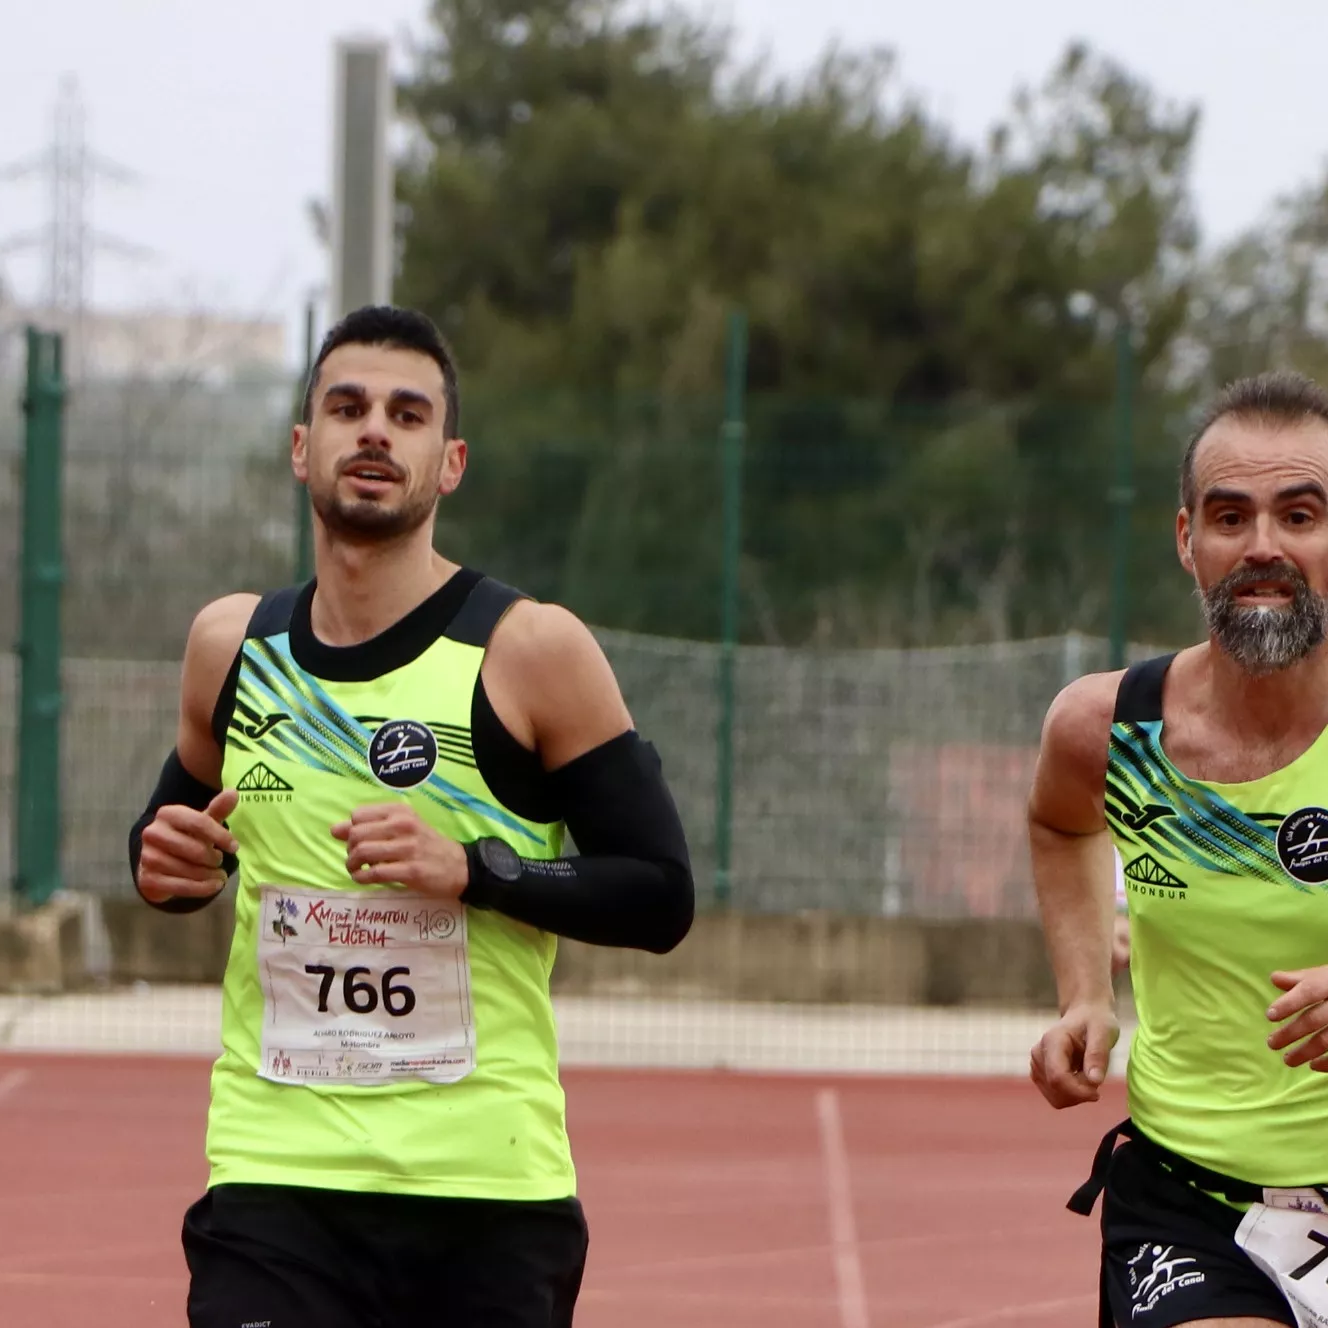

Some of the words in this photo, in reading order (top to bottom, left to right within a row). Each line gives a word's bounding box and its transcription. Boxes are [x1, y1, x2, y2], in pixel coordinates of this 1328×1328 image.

[328, 923, 397, 948] LUCENA
[304, 963, 417, 1018] 766
[1161, 1281, 1175, 1297] del
[1178, 1273, 1205, 1288] Canal
